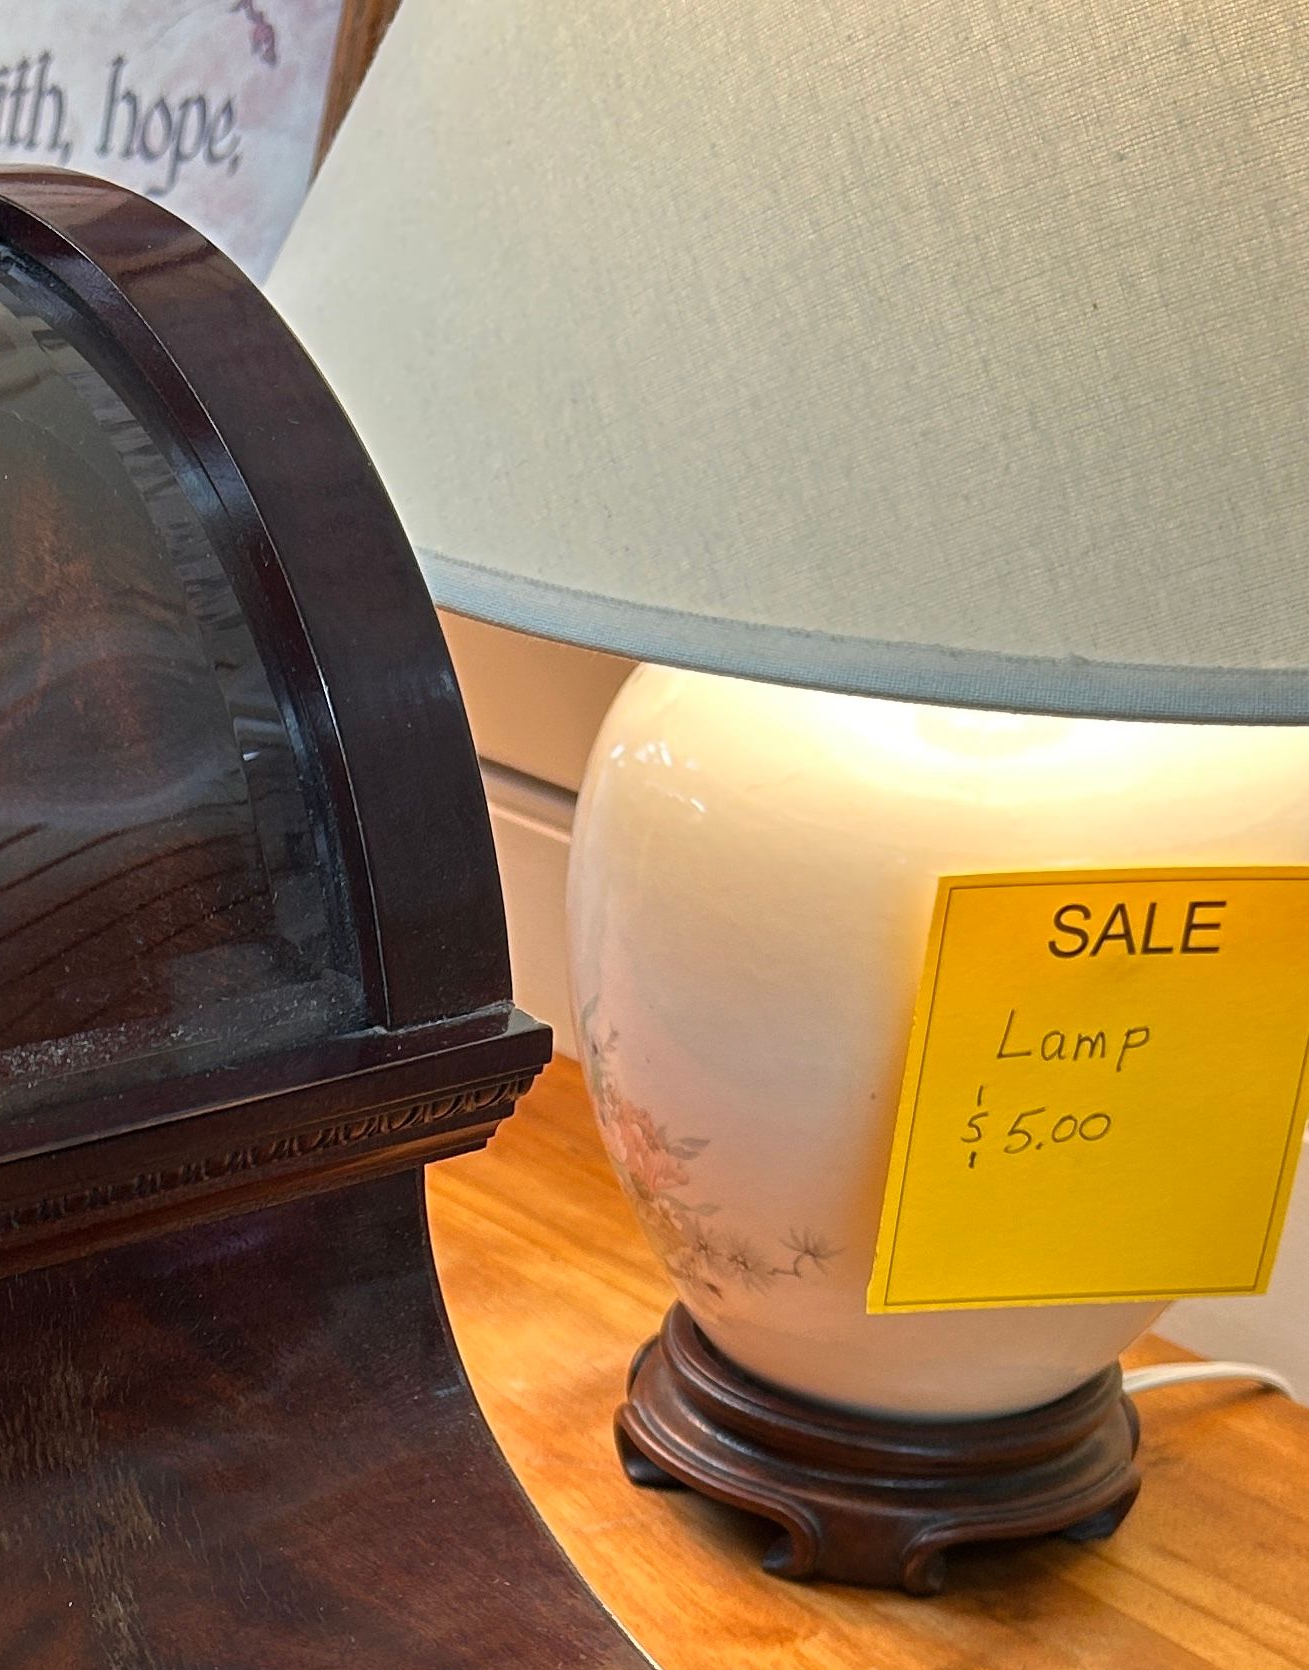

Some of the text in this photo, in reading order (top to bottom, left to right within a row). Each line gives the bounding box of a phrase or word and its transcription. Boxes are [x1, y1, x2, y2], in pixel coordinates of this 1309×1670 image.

[1047, 899, 1228, 959] SALE
[995, 1008, 1151, 1072] Lamp
[959, 1083, 1113, 1169] $5.00
